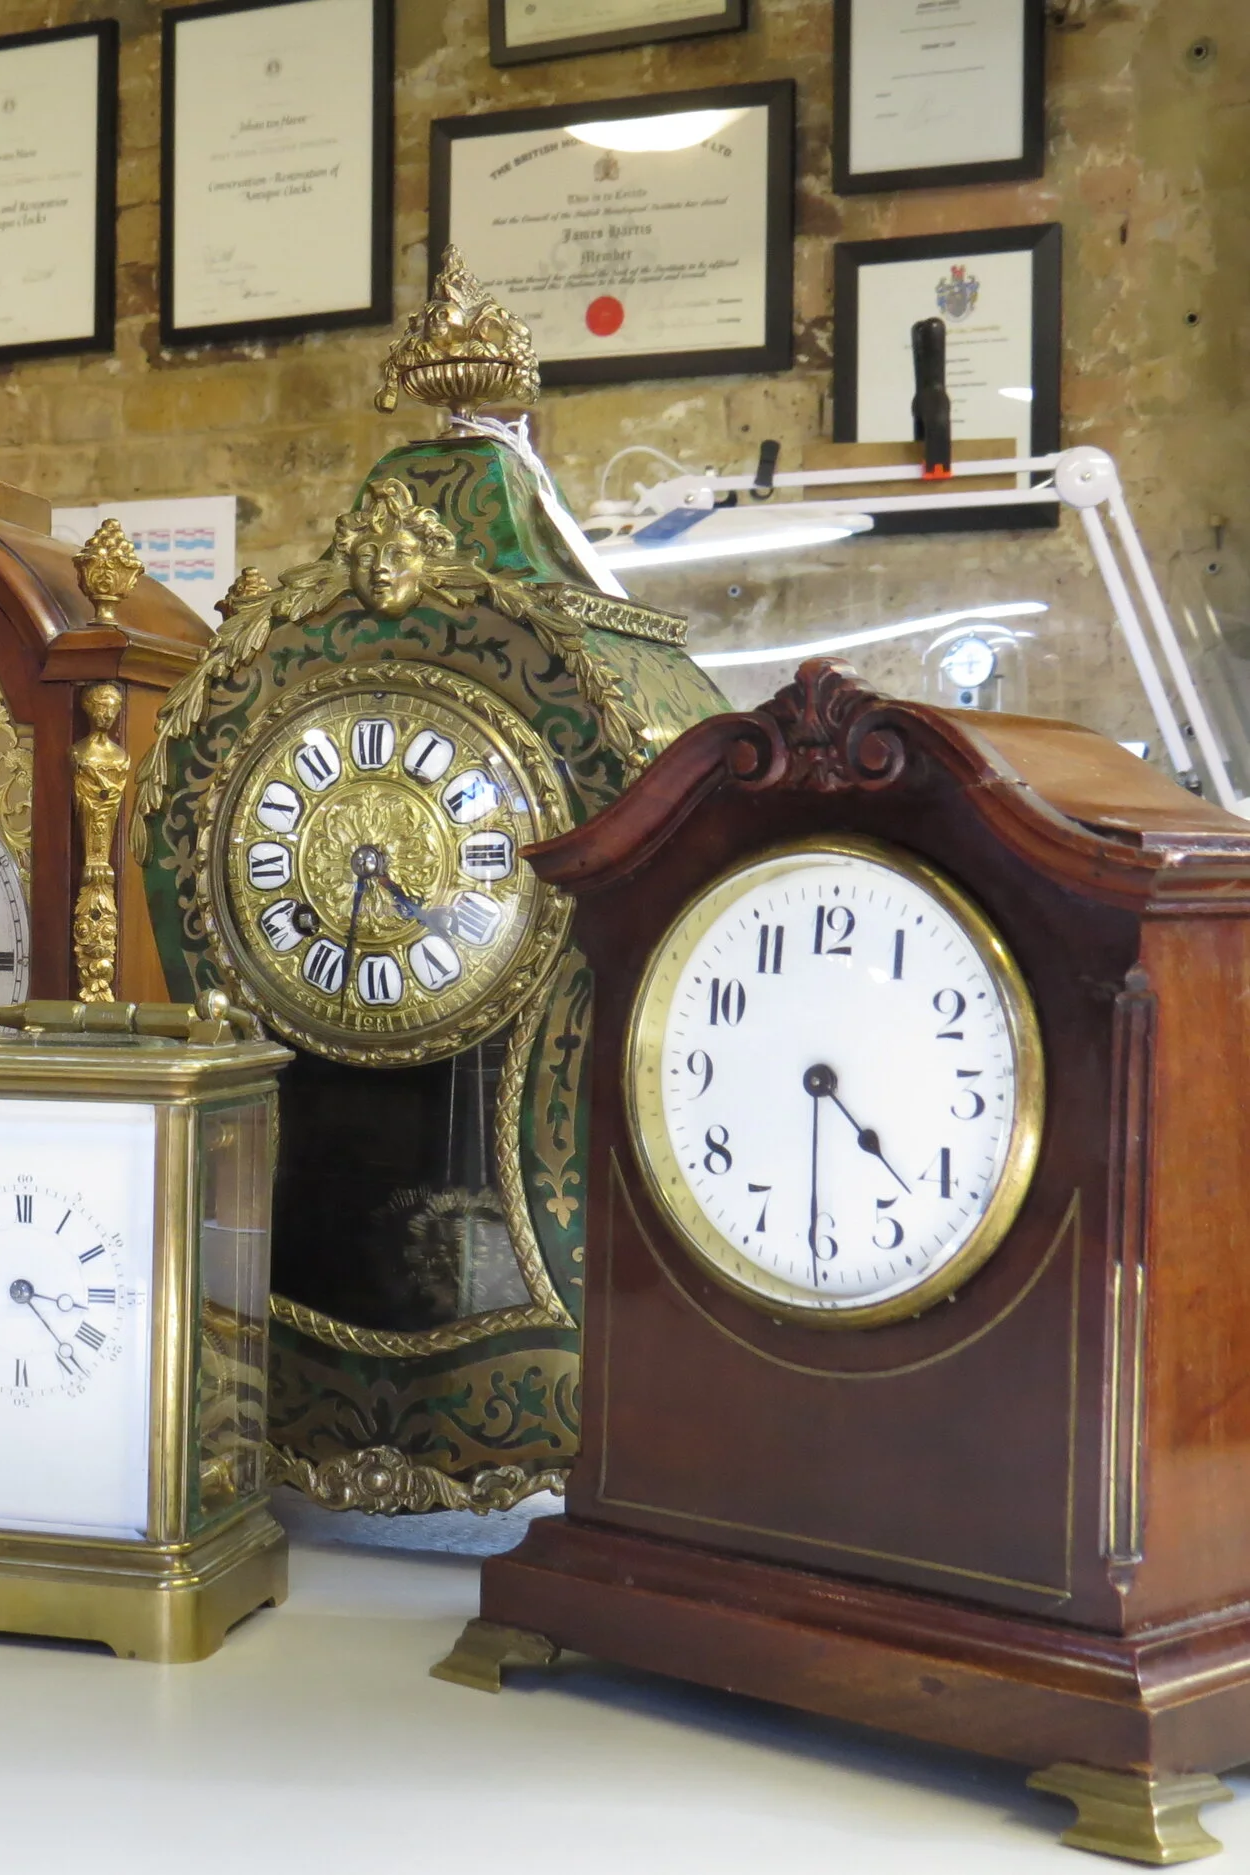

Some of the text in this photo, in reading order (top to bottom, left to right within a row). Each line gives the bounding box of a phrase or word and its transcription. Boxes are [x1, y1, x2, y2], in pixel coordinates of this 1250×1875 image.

[489, 159, 513, 181] THE
[513, 142, 559, 167] BRITISH
[562, 223, 652, 243] James Harris
[580, 248, 632, 265] Member
[756, 924, 785, 975] 11
[812, 905, 856, 956] 12
[891, 929, 905, 980] 1
[706, 977, 747, 1027] 10
[932, 988, 967, 1040] 2
[686, 1049, 714, 1101] 9
[950, 1069, 986, 1121] 3
[703, 1125, 734, 1175] 8
[917, 1147, 959, 1199] 4
[747, 1182, 772, 1233] 7
[871, 1196, 905, 1249] 5
[78, 1242, 106, 1264] II
[813, 1211, 839, 1262] 6
[88, 1287, 116, 1304] III
